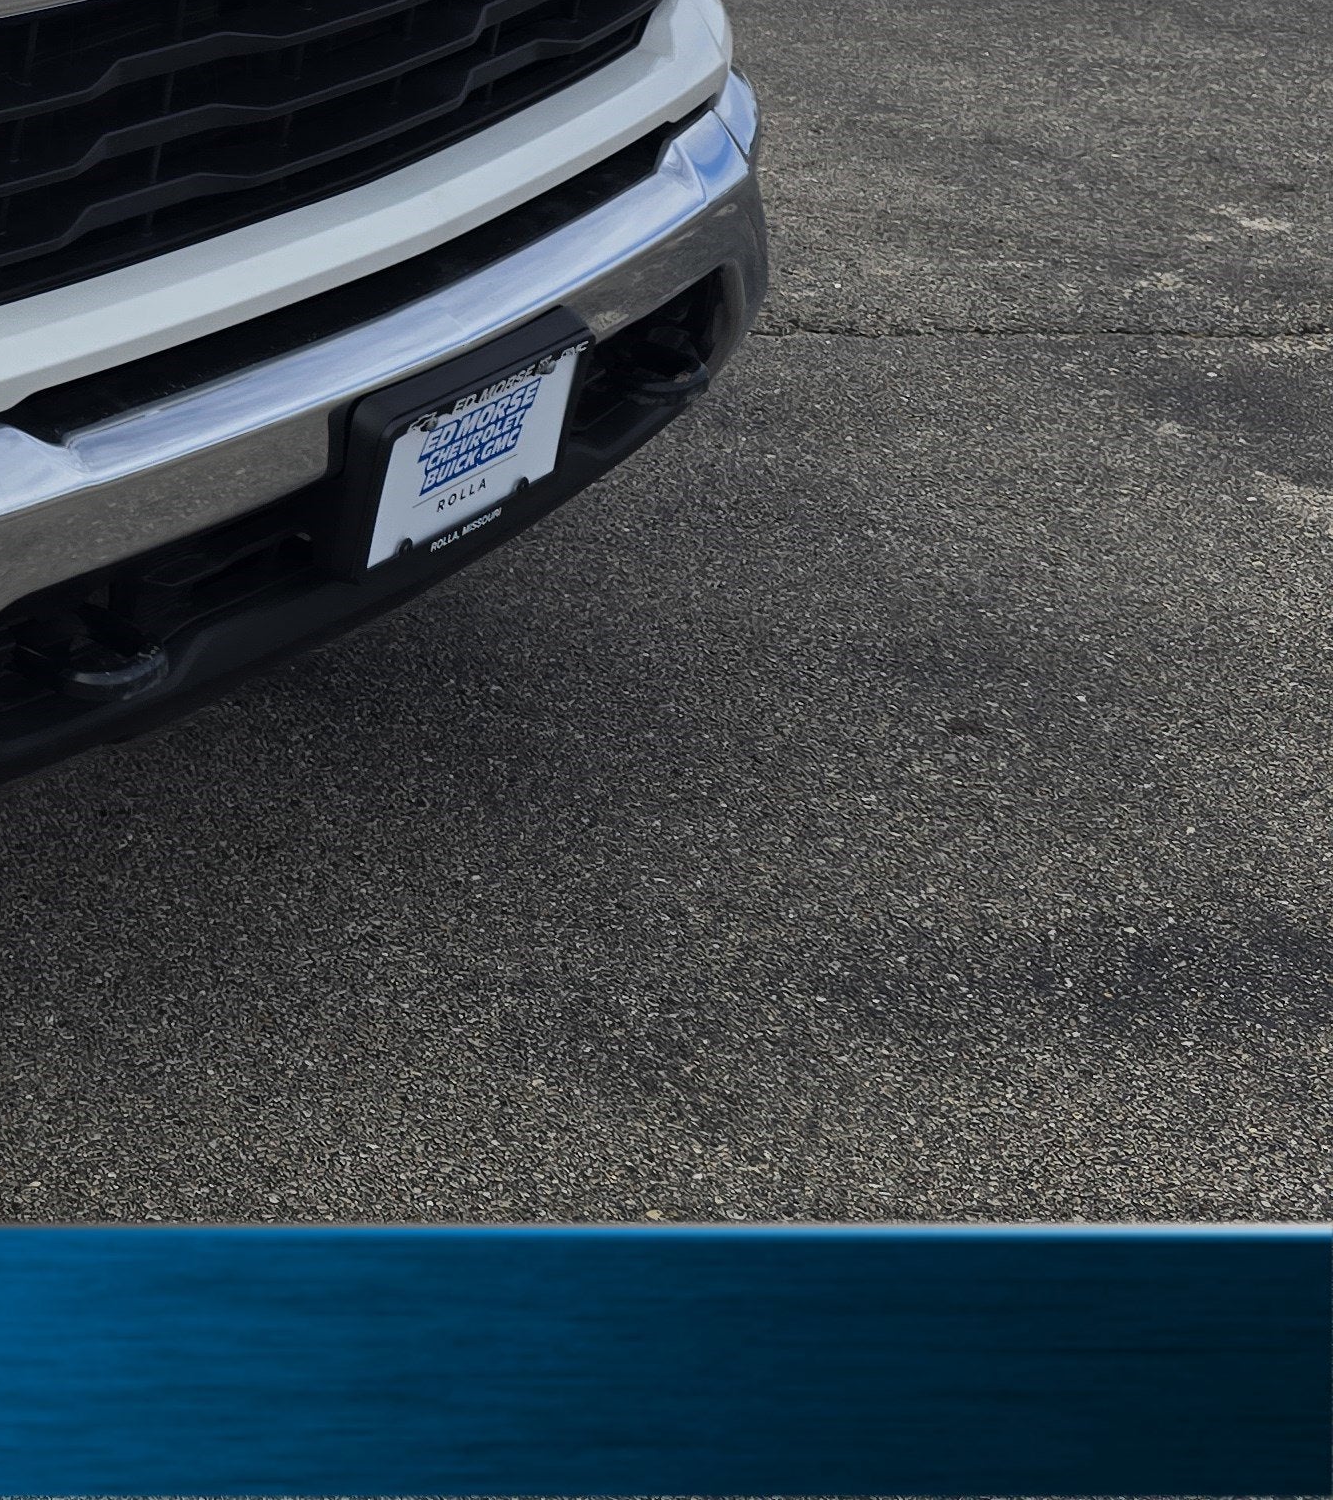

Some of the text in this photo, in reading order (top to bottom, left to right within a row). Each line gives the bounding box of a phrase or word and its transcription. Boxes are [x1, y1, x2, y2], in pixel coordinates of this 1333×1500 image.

[453, 392, 480, 413] ED
[480, 363, 537, 404] MORSE
[420, 380, 539, 458] ED MORSE
[426, 411, 526, 472] CHEVROLET
[436, 477, 487, 513] ROLLA
[461, 506, 503, 536] MISSOURI
